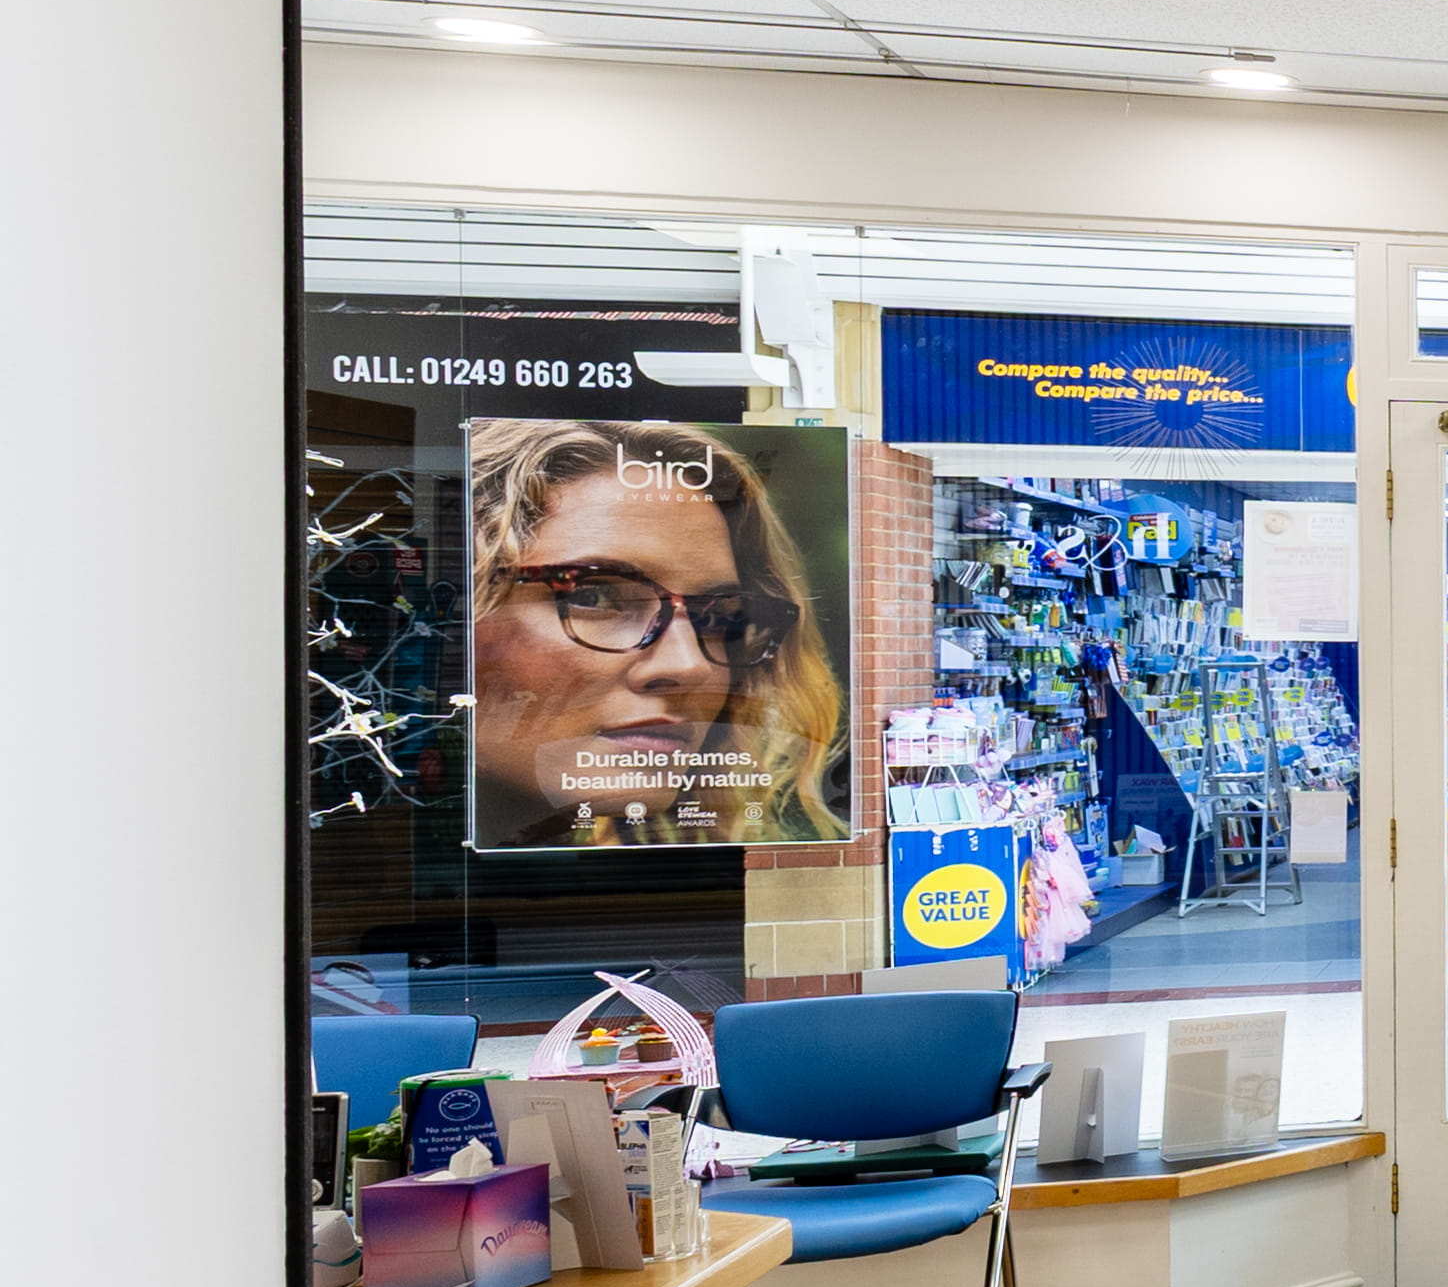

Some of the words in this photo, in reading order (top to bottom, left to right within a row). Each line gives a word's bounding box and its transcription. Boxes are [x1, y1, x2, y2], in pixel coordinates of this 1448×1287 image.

[333, 354, 416, 385] CALL:
[420, 356, 506, 387] 01249
[515, 360, 569, 389] 660
[578, 361, 633, 390] 263
[978, 358, 1083, 381] Compare
[1089, 363, 1126, 380] the
[1132, 364, 1229, 386] quality...
[1035, 380, 1139, 403] Compare
[1144, 383, 1181, 401] the
[1186, 385, 1264, 405] price...
[616, 442, 713, 491] bird
[616, 493, 714, 503] EYEWEAR
[576, 749, 669, 768] Durable
[671, 749, 758, 768] frames,
[561, 771, 663, 791] beautiful
[667, 771, 697, 792] by
[700, 771, 773, 788] nature
[677, 819, 717, 827] AWARDS
[918, 889, 990, 906] GREAT
[920, 906, 990, 923] VALUE
[425, 1126, 440, 1134] No
[442, 1125, 460, 1133] one
[463, 1121, 494, 1132] should
[431, 1134, 462, 1144] forced
[440, 1144, 457, 1153] the
[481, 1218, 550, 1257] Daydream
